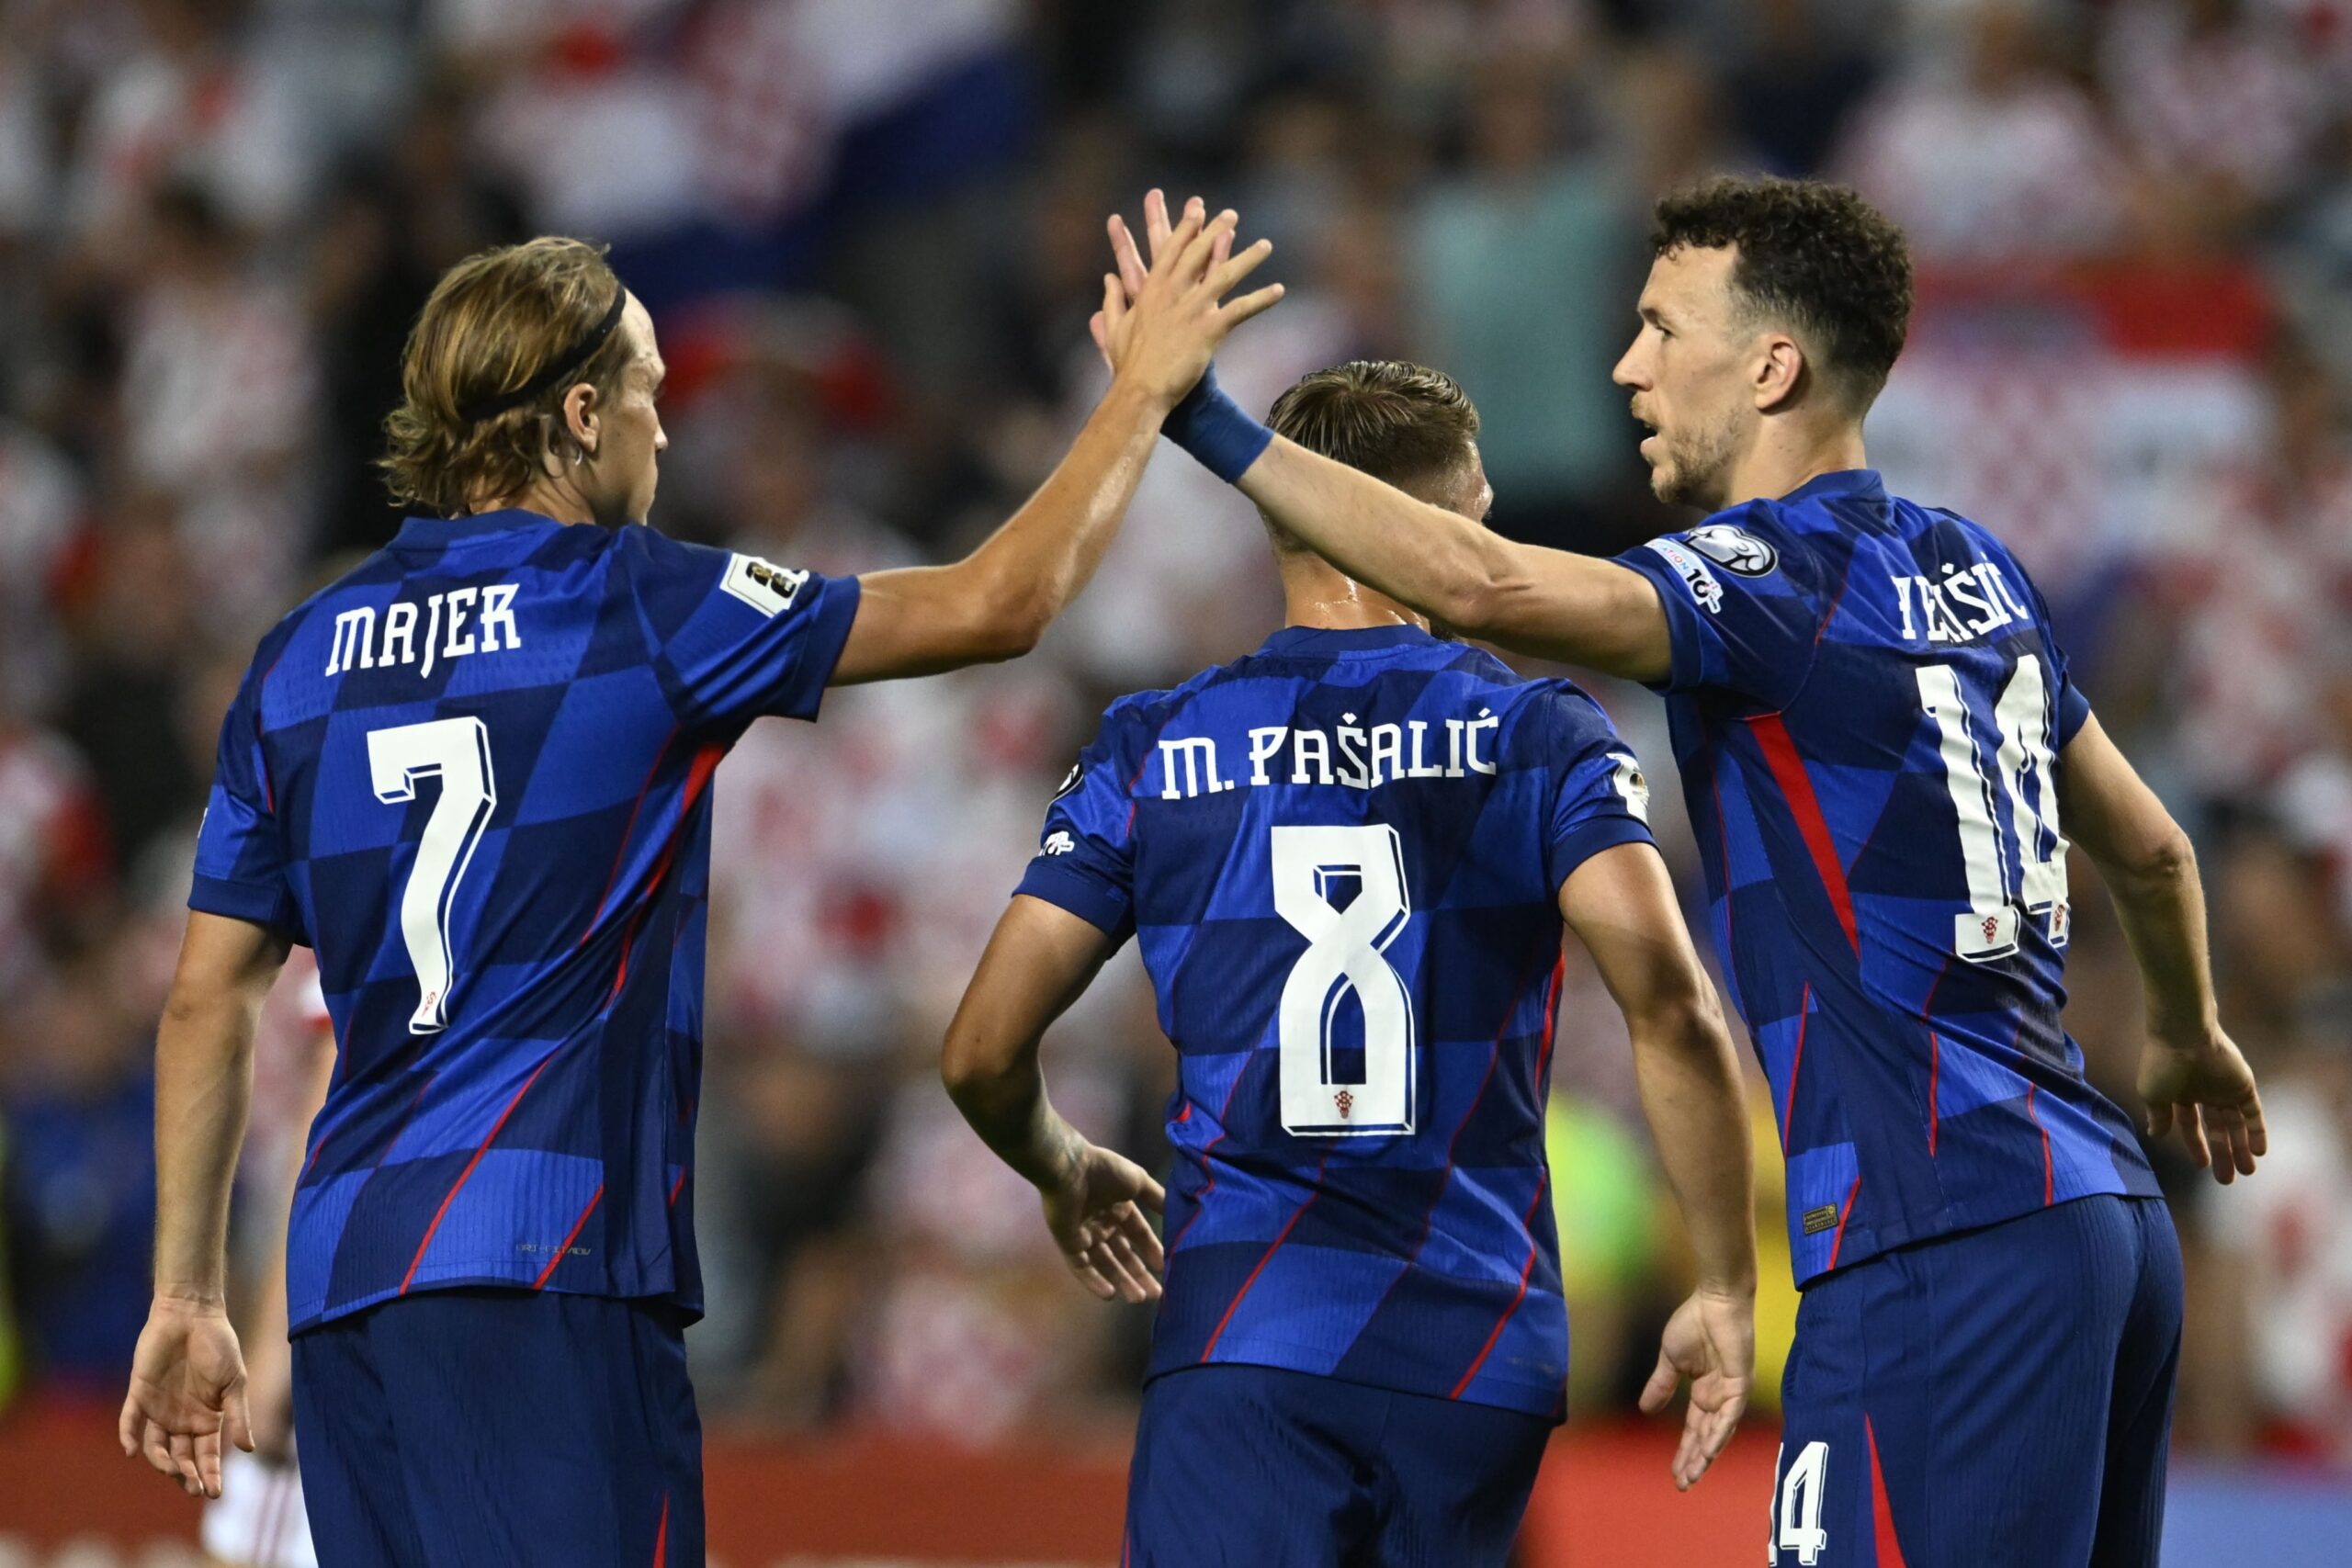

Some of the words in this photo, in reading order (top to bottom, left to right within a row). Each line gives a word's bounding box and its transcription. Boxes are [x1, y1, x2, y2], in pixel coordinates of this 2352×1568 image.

[324, 583, 521, 679] MAJER
[1159, 737, 1235, 800] M.
[1248, 707, 1499, 790] PAŠALIĆ
[367, 716, 497, 1035] 7
[1916, 653, 2071, 964] 14
[1271, 823, 1416, 1137] 8
